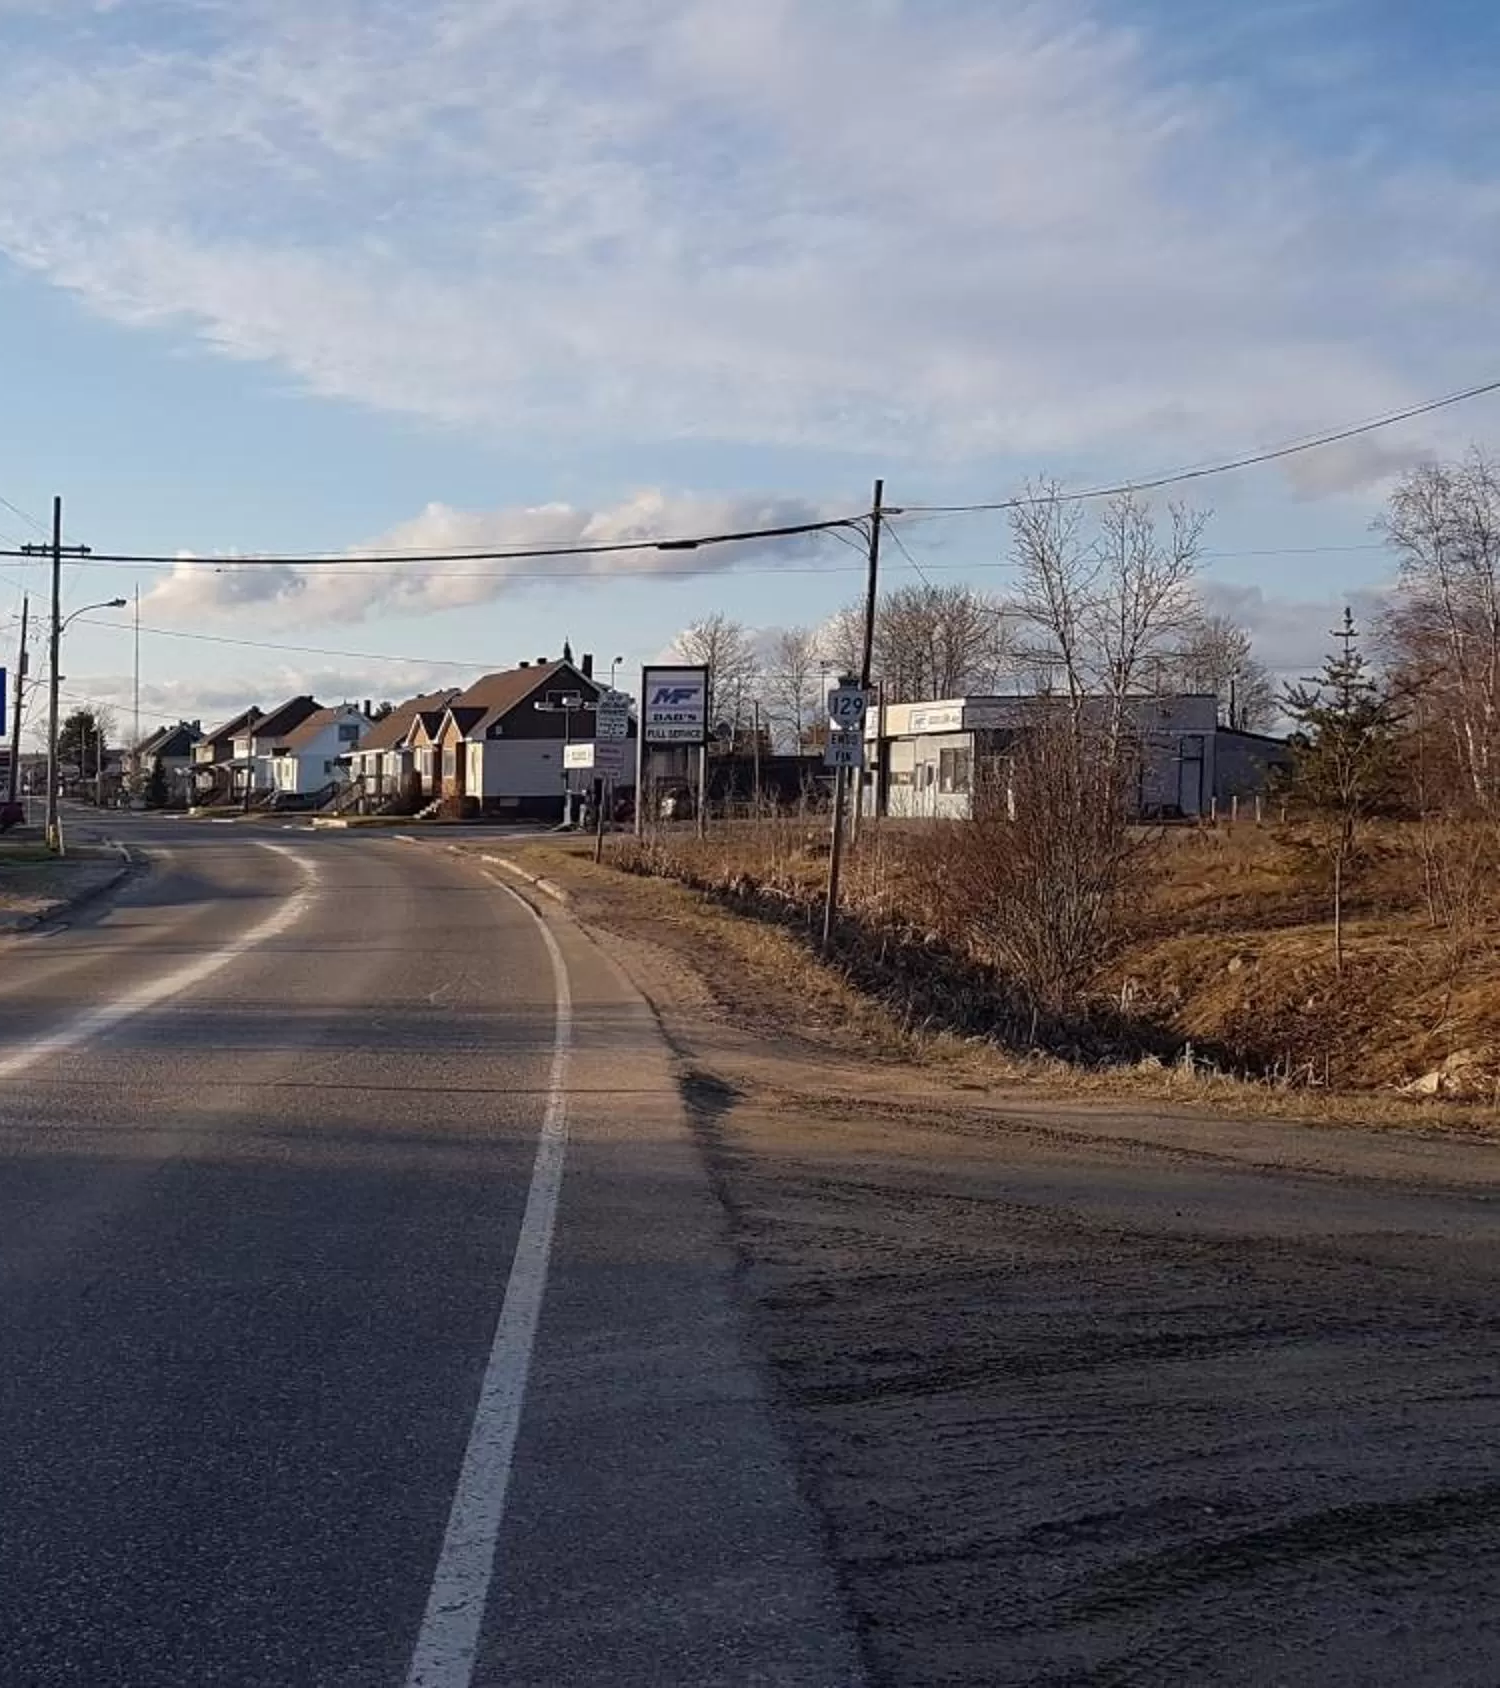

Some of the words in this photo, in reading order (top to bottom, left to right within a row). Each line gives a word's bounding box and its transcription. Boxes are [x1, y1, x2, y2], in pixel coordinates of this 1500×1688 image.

[833, 697, 863, 715] 129
[647, 729, 666, 738] FULL
[668, 729, 702, 738] SERVICE
